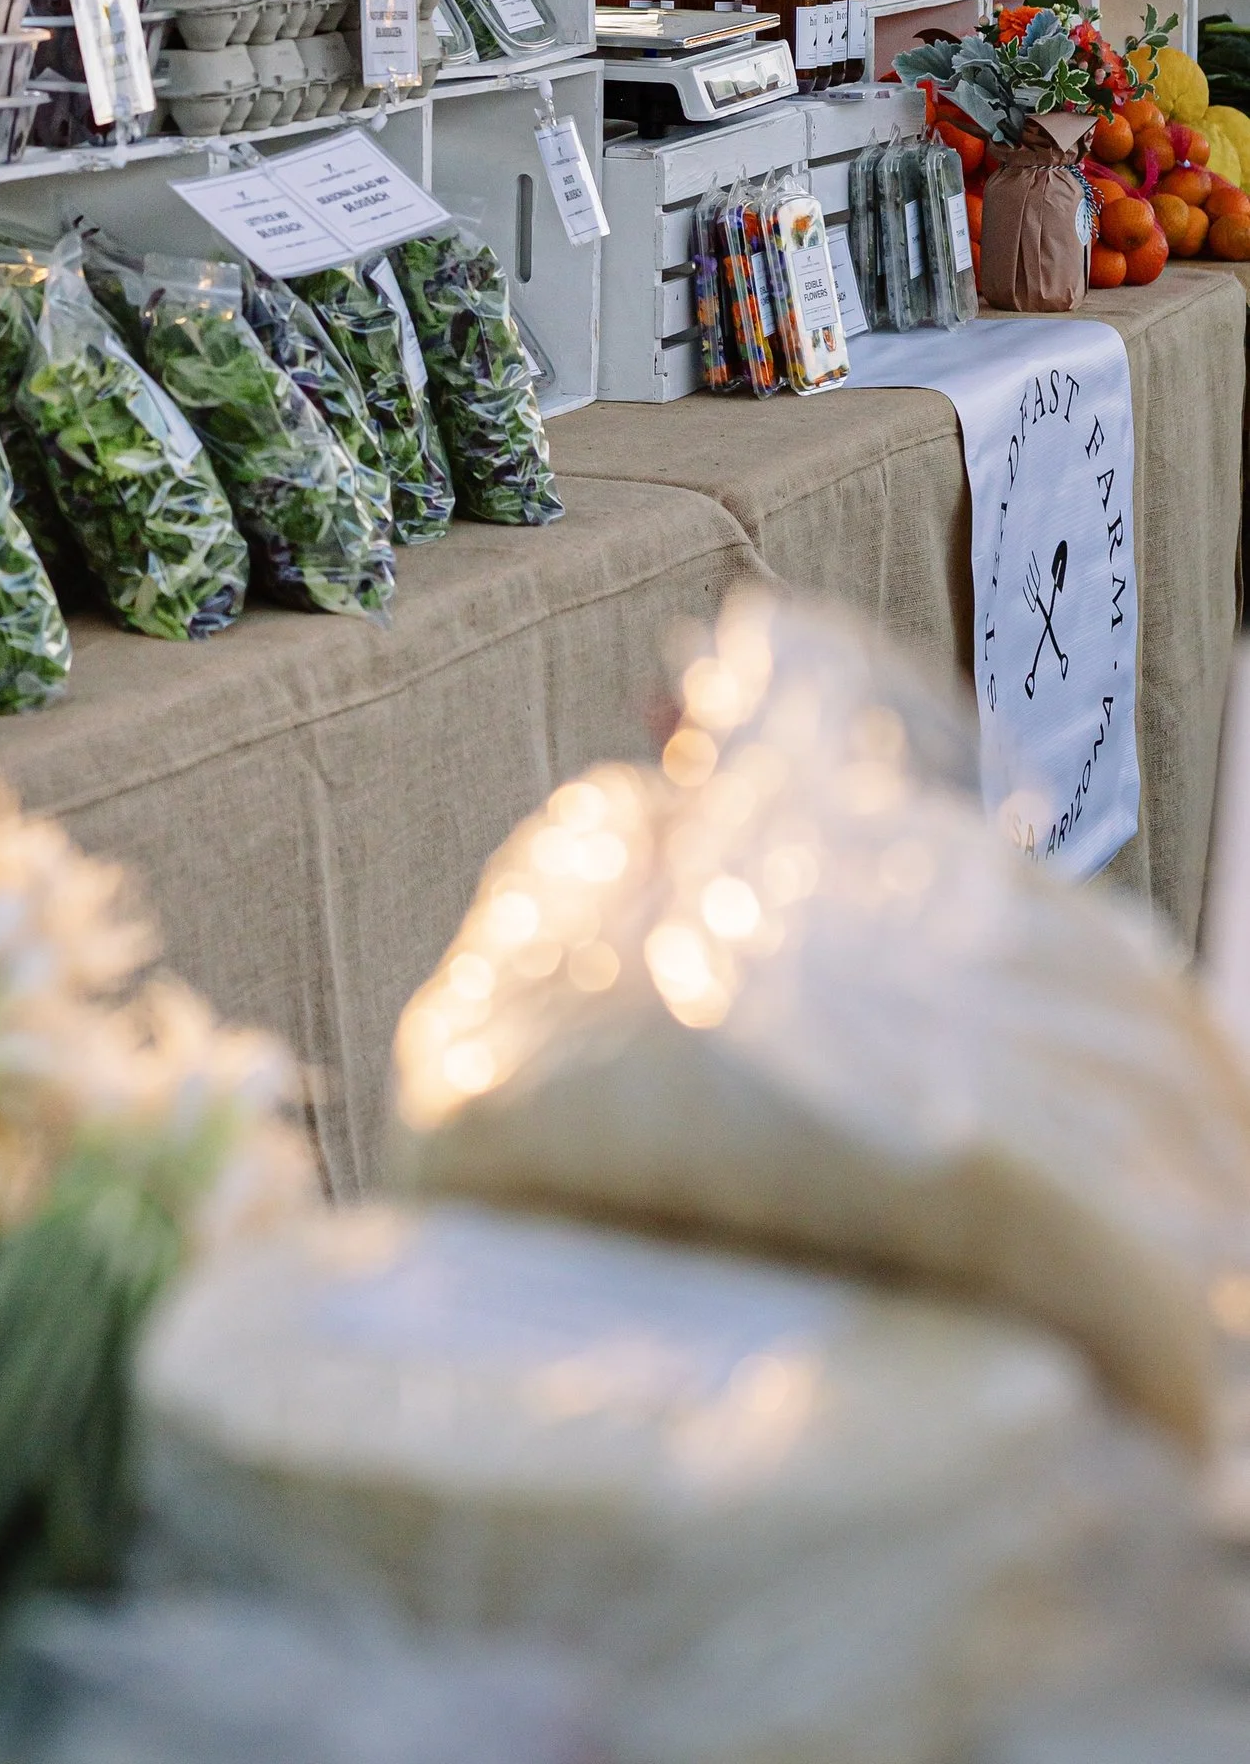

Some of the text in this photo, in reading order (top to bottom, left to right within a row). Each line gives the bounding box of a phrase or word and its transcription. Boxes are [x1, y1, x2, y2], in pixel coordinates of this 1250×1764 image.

[803, 288, 828, 303] FLOWERS
[804, 278, 823, 291] EDIBLE
[1084, 414, 1126, 633] FARM
[1046, 696, 1114, 860] ARIZONA
